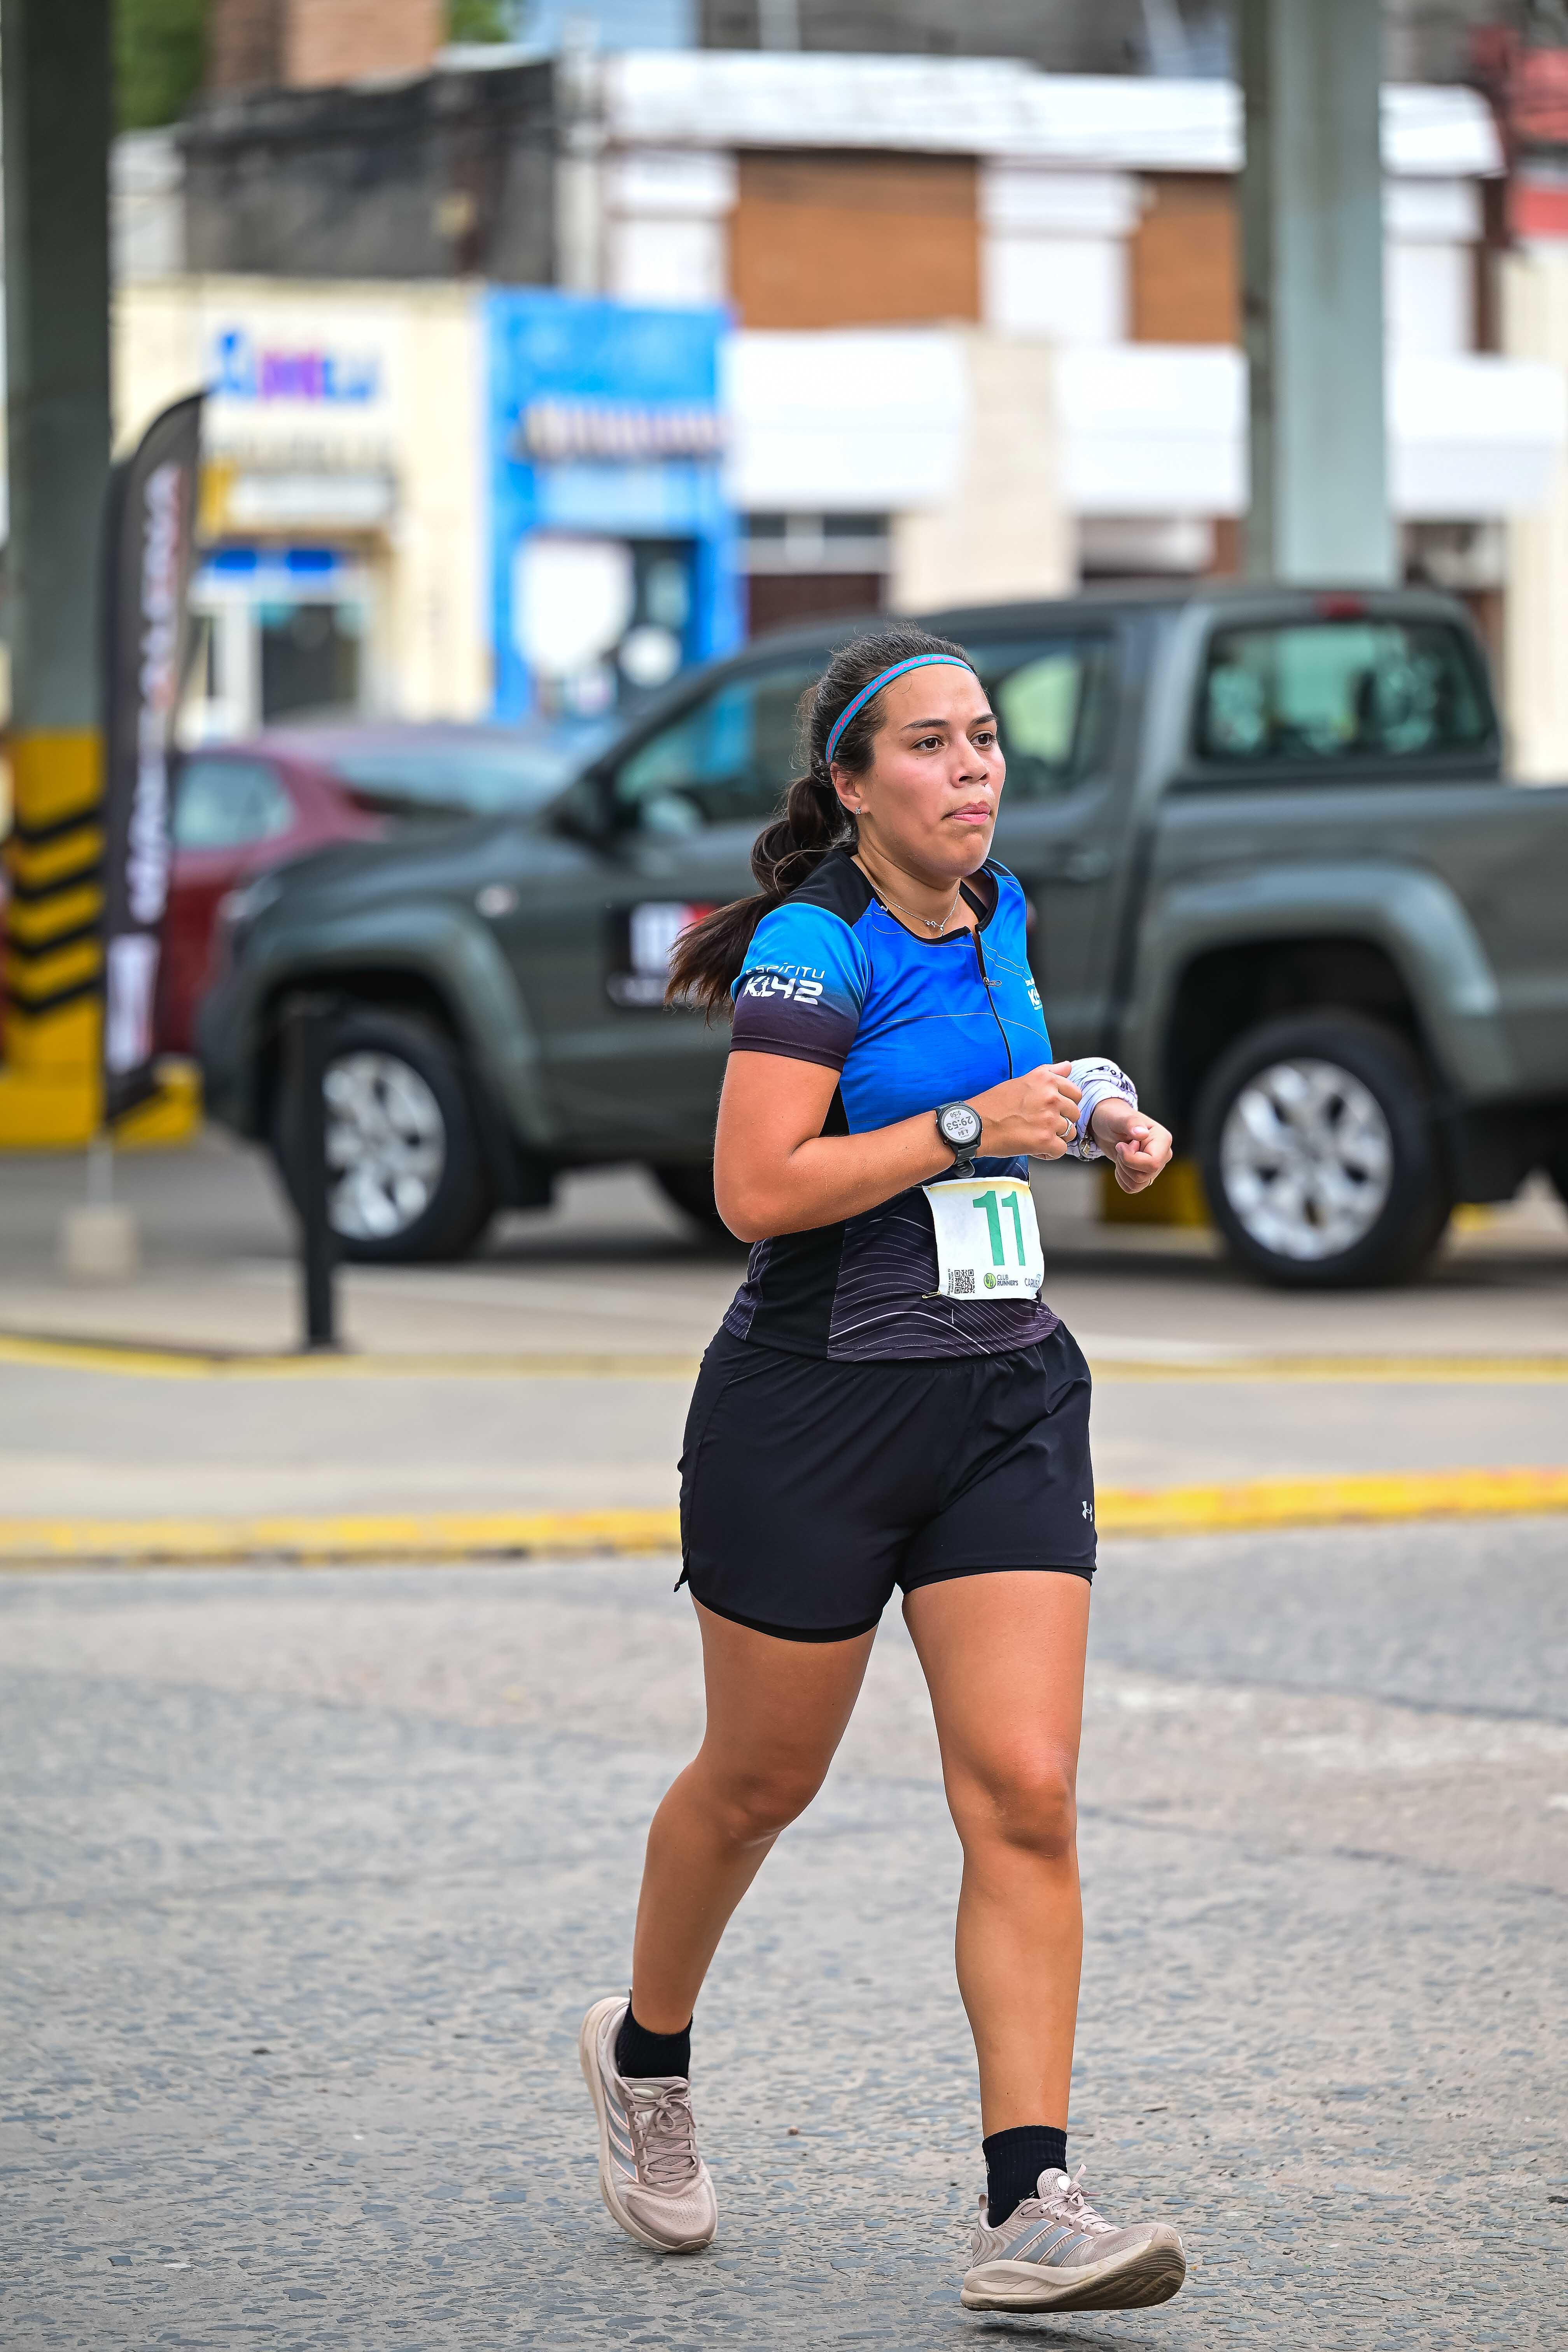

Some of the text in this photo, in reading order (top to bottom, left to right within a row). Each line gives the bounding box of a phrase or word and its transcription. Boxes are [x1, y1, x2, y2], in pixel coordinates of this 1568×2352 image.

[946, 1116, 973, 1131] 29:53
[972, 1190, 1026, 1266] 11
[1024, 1278, 1040, 1288] CARUSO
